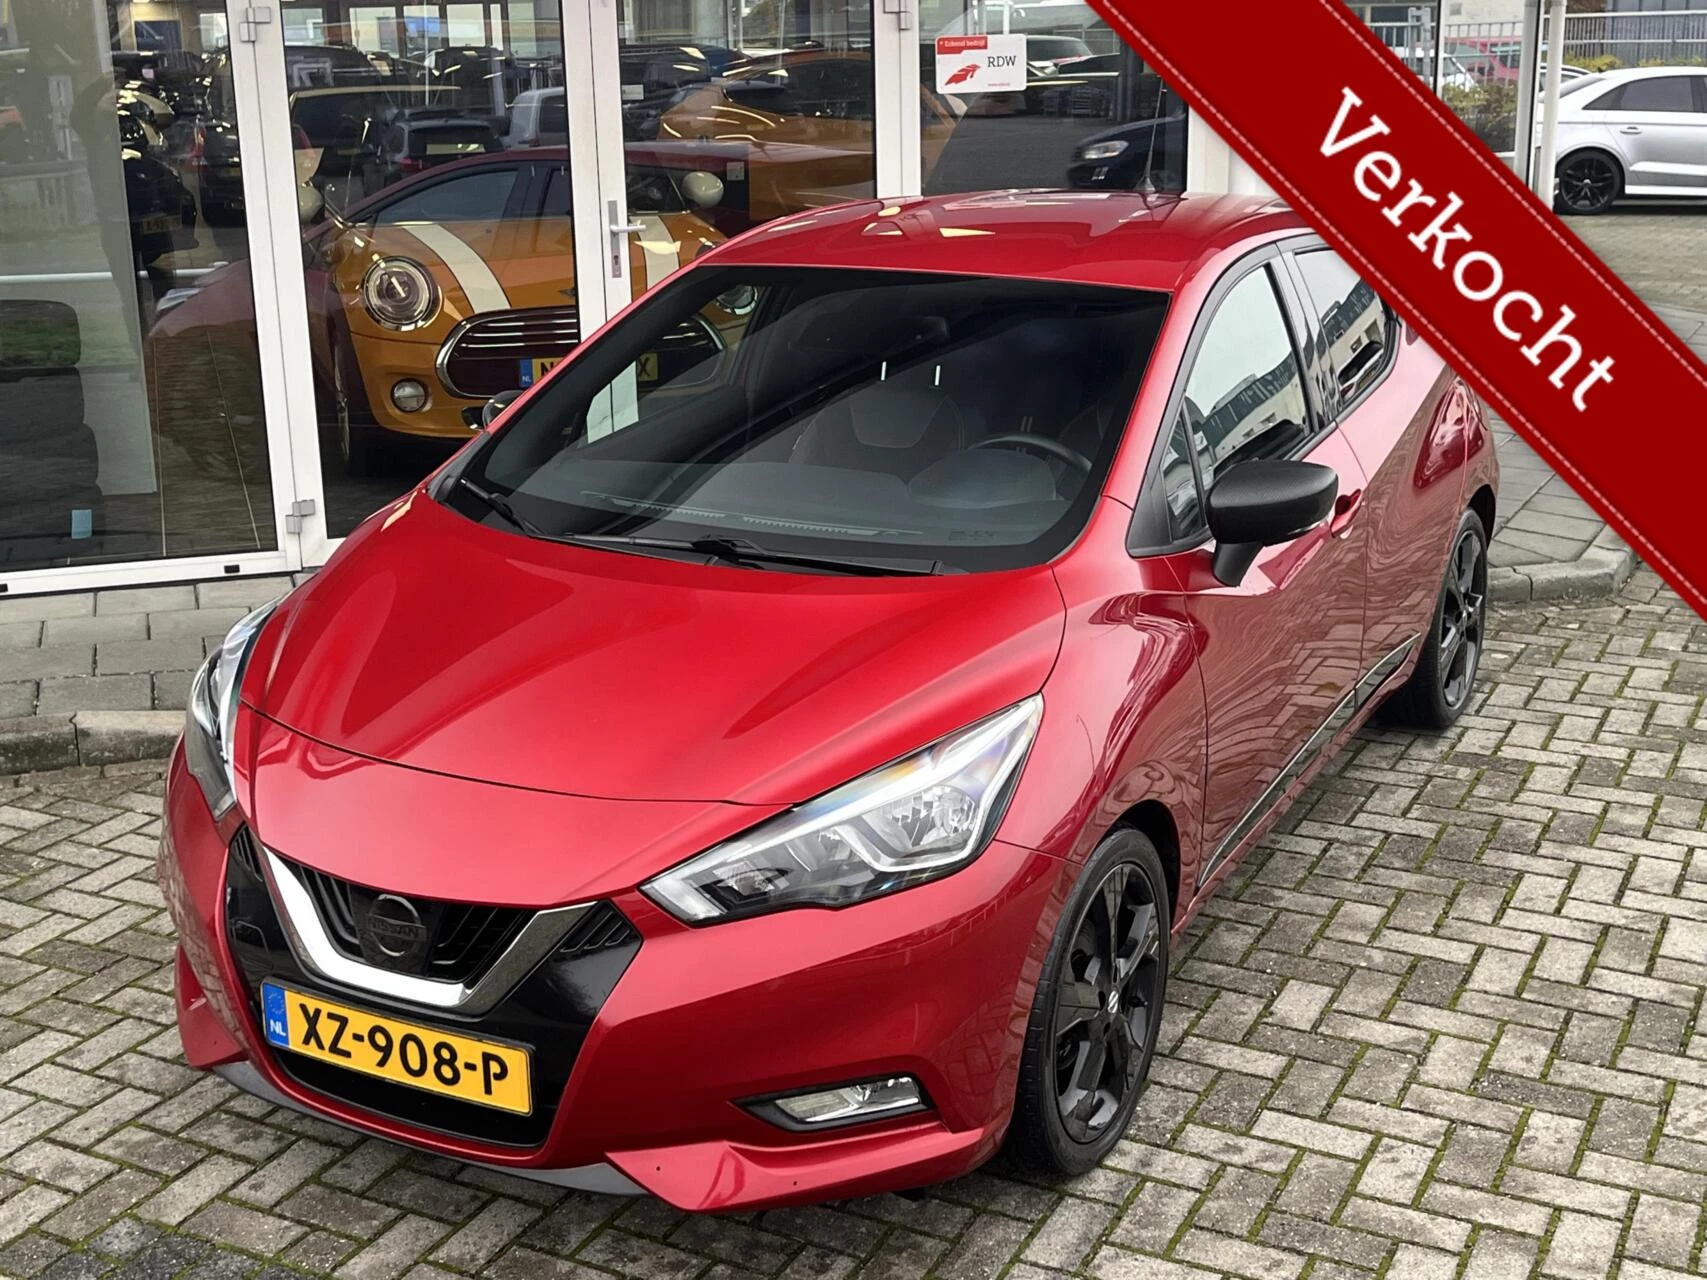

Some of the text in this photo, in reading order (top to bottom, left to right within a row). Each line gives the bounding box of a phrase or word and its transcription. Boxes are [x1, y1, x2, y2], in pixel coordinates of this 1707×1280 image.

[987, 55, 1016, 68] RDW
[270, 1019, 287, 1037] NL
[298, 1003, 509, 1096] XZ-908-P
